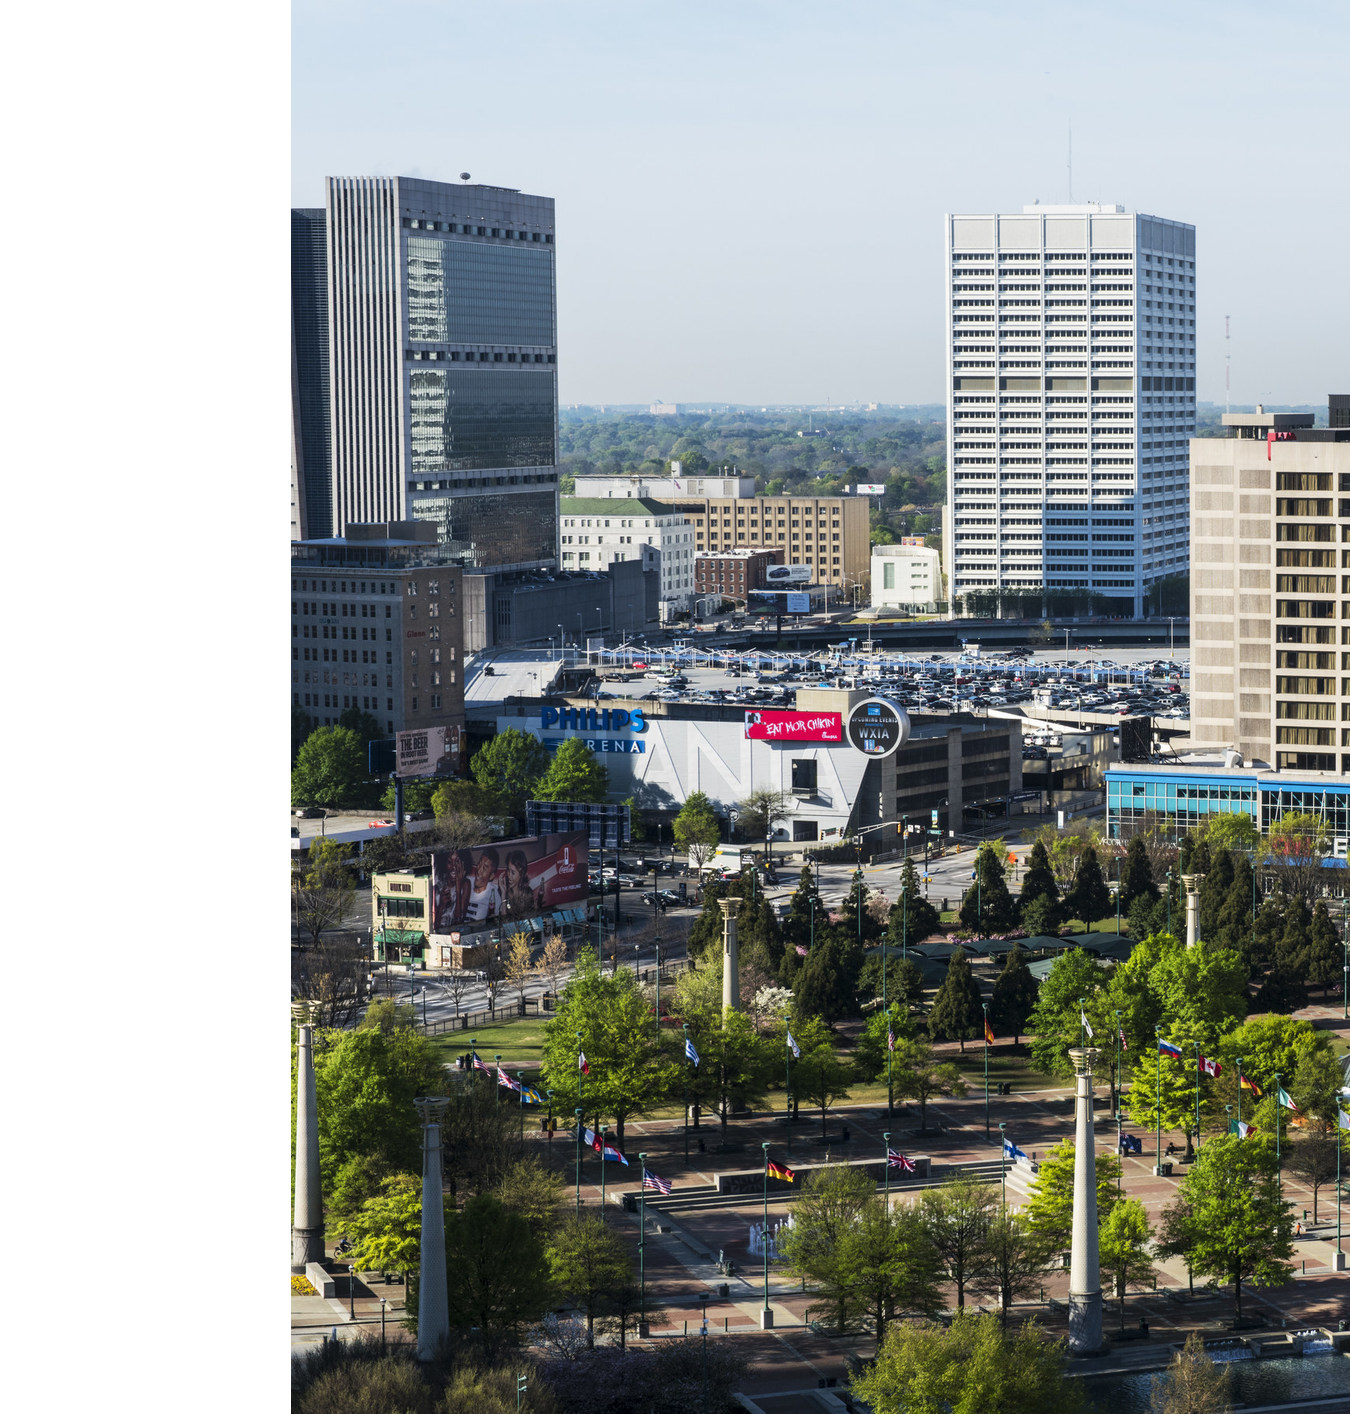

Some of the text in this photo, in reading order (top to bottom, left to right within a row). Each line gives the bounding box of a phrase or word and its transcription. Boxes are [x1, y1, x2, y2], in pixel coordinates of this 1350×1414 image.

[541, 706, 645, 732] PHILIPS
[766, 717, 835, 736] EAT MOR CHIKIN
[859, 728, 889, 739] WXIA
[401, 736, 428, 751] THE BEER
[574, 740, 640, 753] RENA
